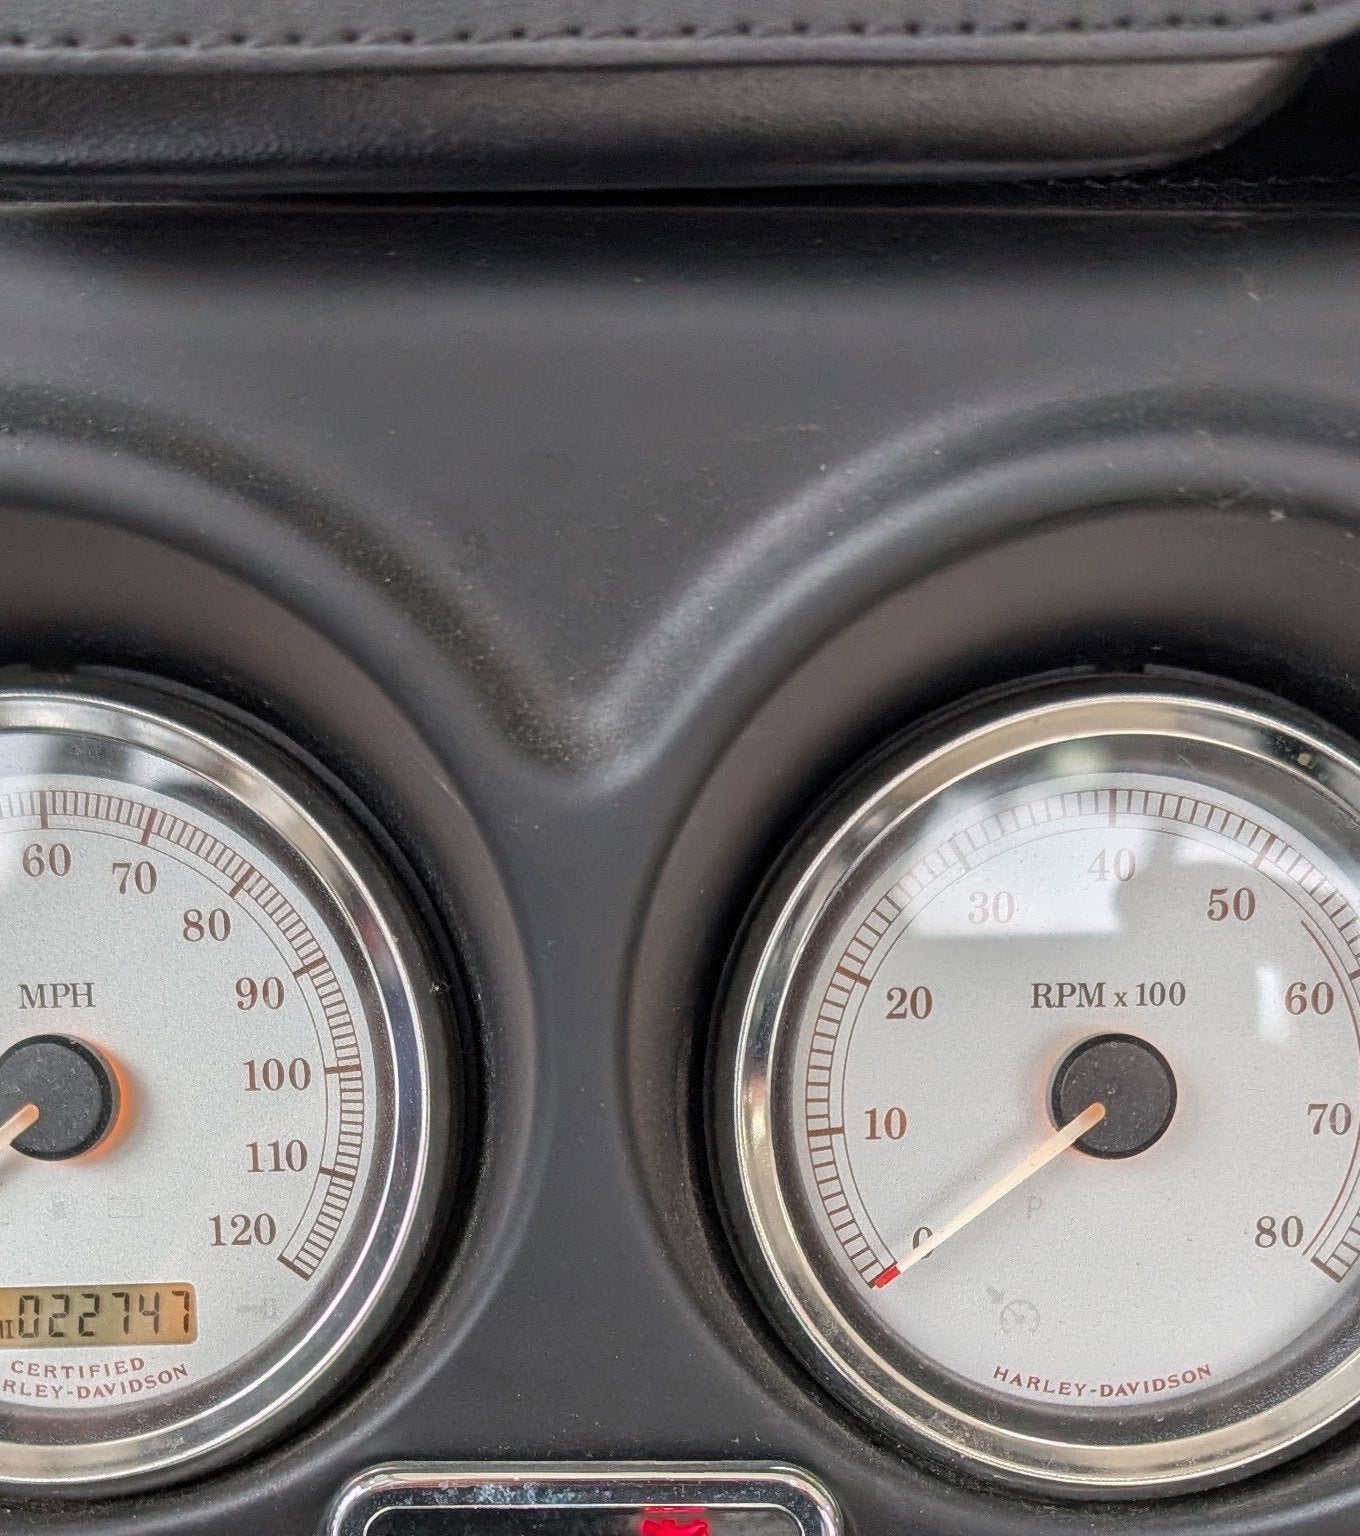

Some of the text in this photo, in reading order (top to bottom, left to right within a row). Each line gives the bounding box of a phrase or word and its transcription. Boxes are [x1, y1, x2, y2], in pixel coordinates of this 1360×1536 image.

[22, 843, 72, 877] 60
[1087, 849, 1136, 882] 40
[112, 862, 158, 895] 70
[968, 891, 1016, 924] 30
[1207, 888, 1256, 921] 50
[183, 909, 231, 942] 80
[19, 982, 96, 1010] MPH
[236, 977, 285, 1010] 90
[886, 986, 933, 1020] 20
[1031, 982, 1187, 1008] RPM x 100
[1285, 982, 1334, 1015] 60
[243, 1058, 311, 1091] 100
[864, 1108, 907, 1140] 10
[1308, 1103, 1352, 1136] 70
[247, 1140, 307, 1172] 110
[209, 1213, 277, 1246] 120
[1255, 1216, 1304, 1248] 80
[18, 1291, 190, 1339] 022747
[11, 1357, 145, 1380] CERTIFIED
[993, 1364, 1212, 1398] HARLEY-DAVIDSON
